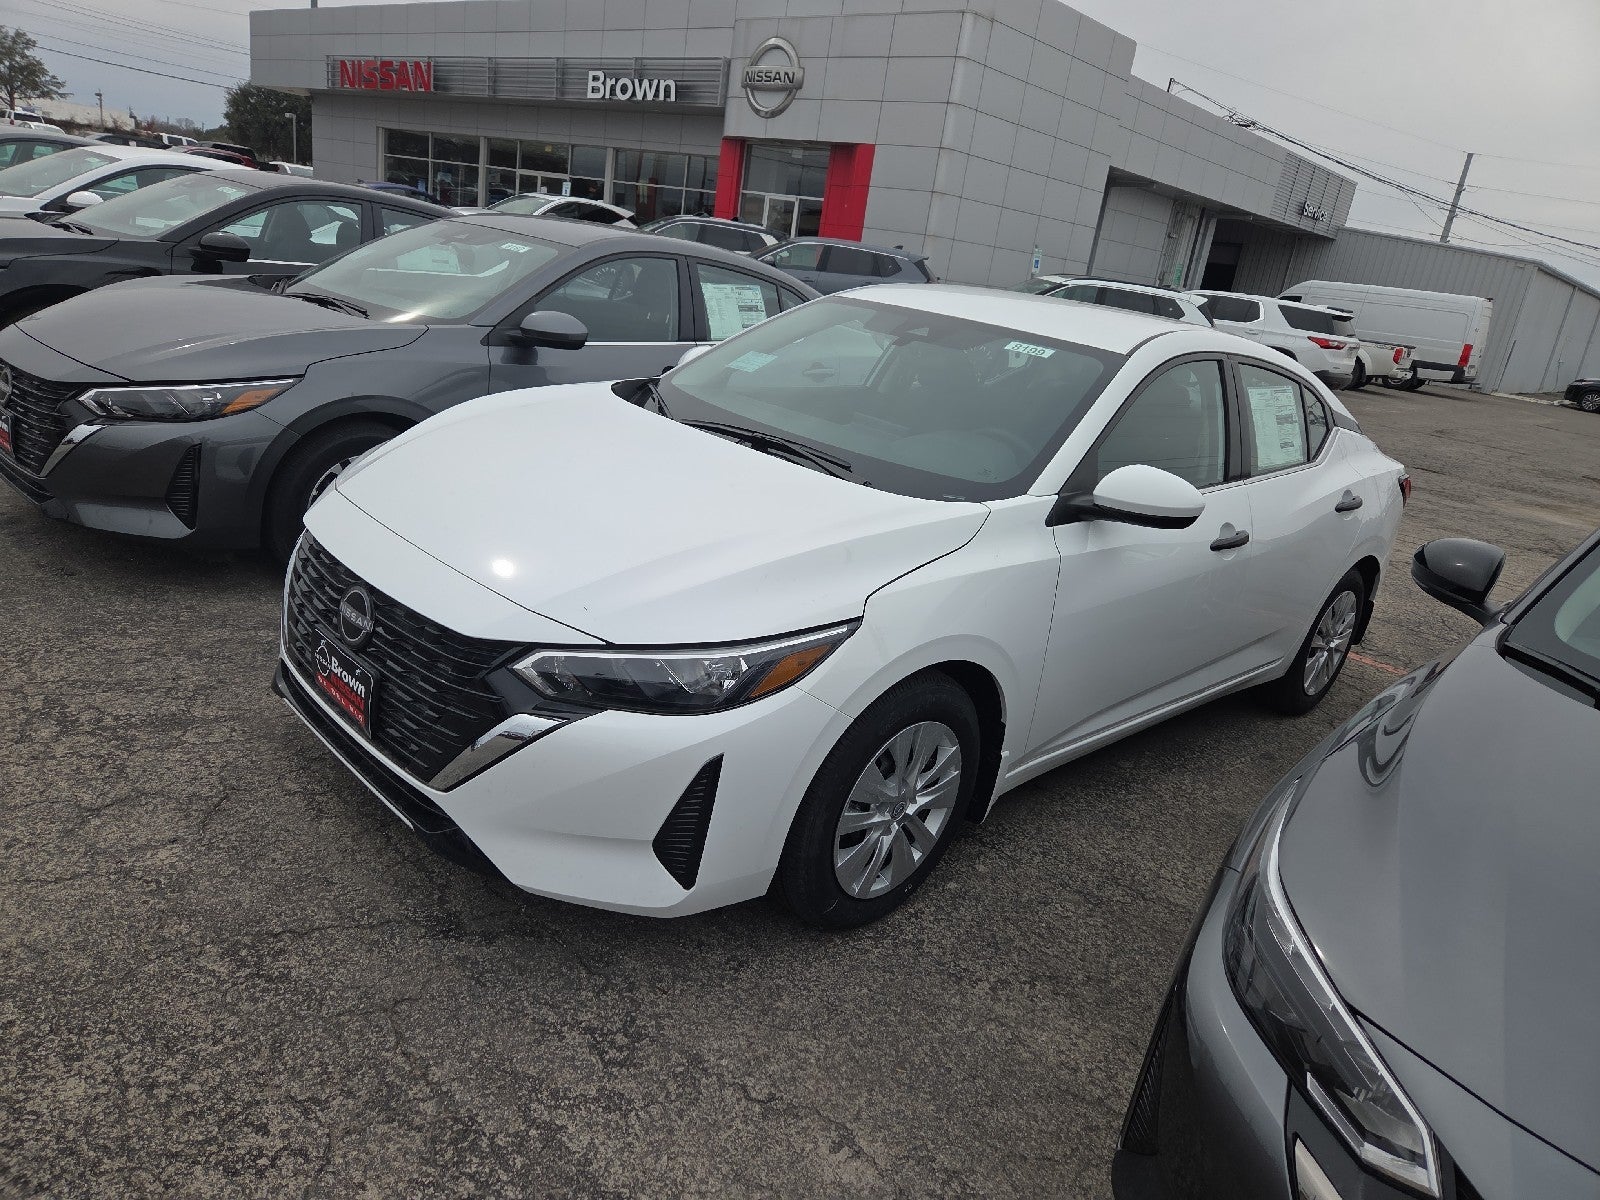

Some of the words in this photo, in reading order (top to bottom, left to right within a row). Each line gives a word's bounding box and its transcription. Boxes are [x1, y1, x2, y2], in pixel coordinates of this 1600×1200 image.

[339, 60, 433, 92] NISSAN
[587, 71, 676, 101] Brown
[744, 70, 795, 84] NISSAN
[1303, 201, 1327, 221] Service
[341, 603, 374, 632] NISSAN
[331, 656, 365, 698] Brown
[331, 674, 365, 710] NISSAN
